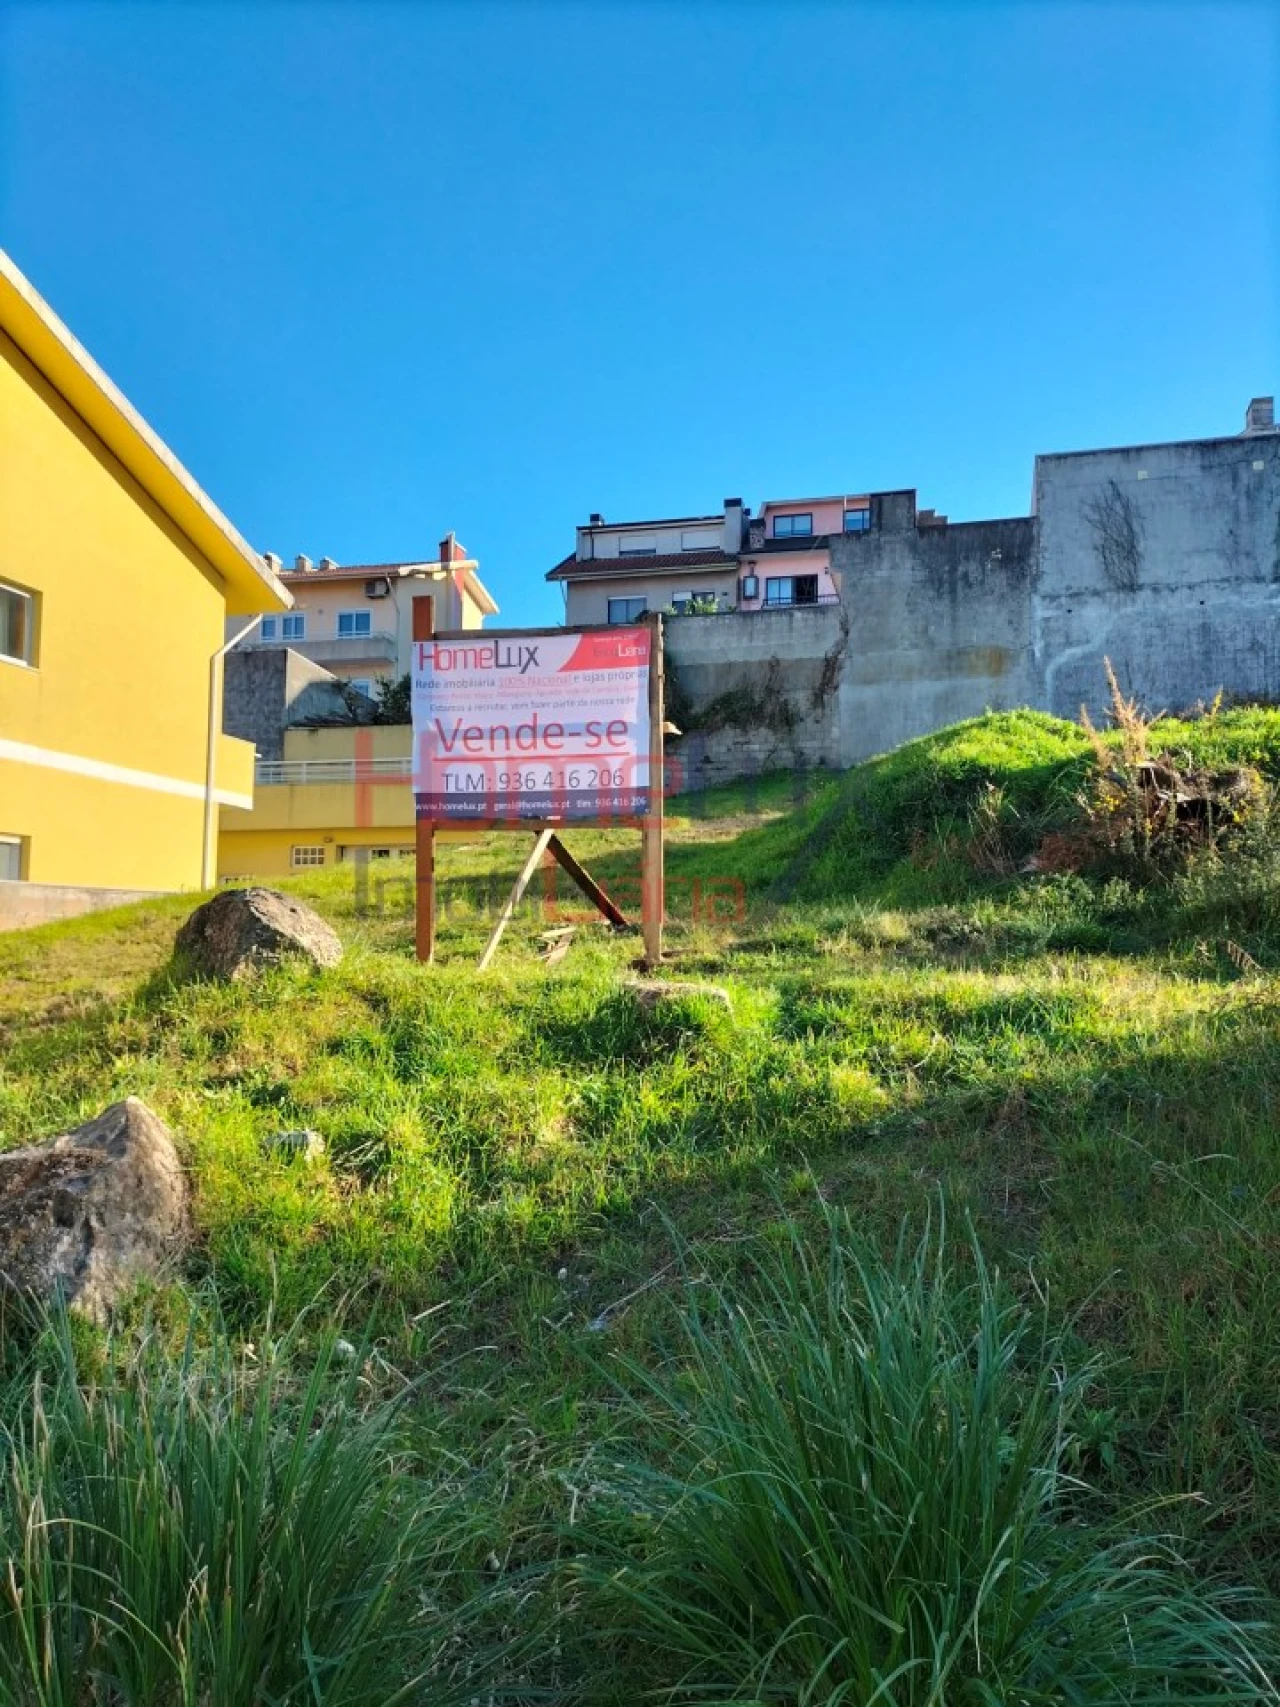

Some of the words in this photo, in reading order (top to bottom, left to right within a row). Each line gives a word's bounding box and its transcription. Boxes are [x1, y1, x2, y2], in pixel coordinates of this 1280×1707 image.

[418, 639, 540, 675] HomeLux
[415, 680, 441, 689] Rede
[582, 673, 606, 684] lojas
[434, 713, 629, 753] Vende-se
[441, 772, 491, 792] TLM:
[499, 771, 537, 791] 936
[543, 770, 581, 789] 416
[588, 768, 625, 788] 206
[415, 800, 487, 812] www.homelux.pt
